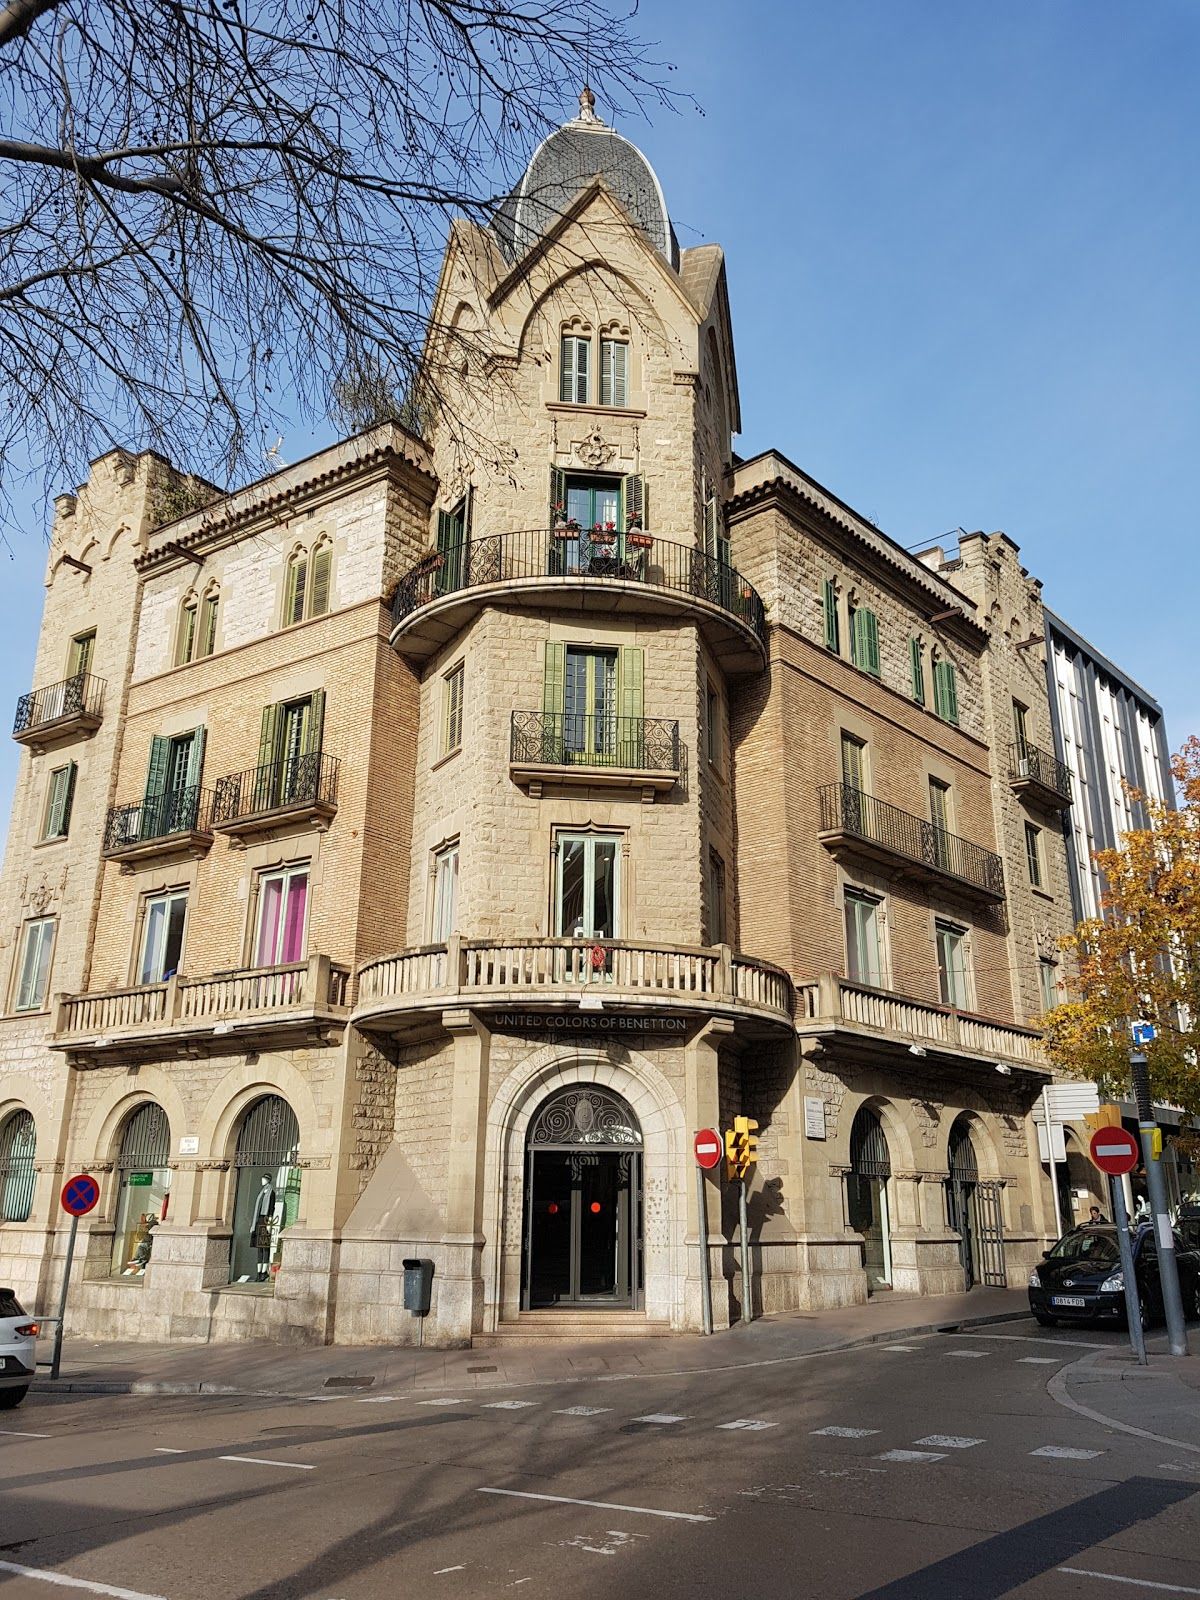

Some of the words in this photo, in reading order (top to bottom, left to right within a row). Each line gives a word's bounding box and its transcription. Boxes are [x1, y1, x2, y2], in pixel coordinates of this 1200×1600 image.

[495, 1014, 543, 1027] UNITED
[545, 1015, 596, 1028] COLORS
[599, 1017, 617, 1029] OF
[619, 1017, 687, 1030] BENETTON
